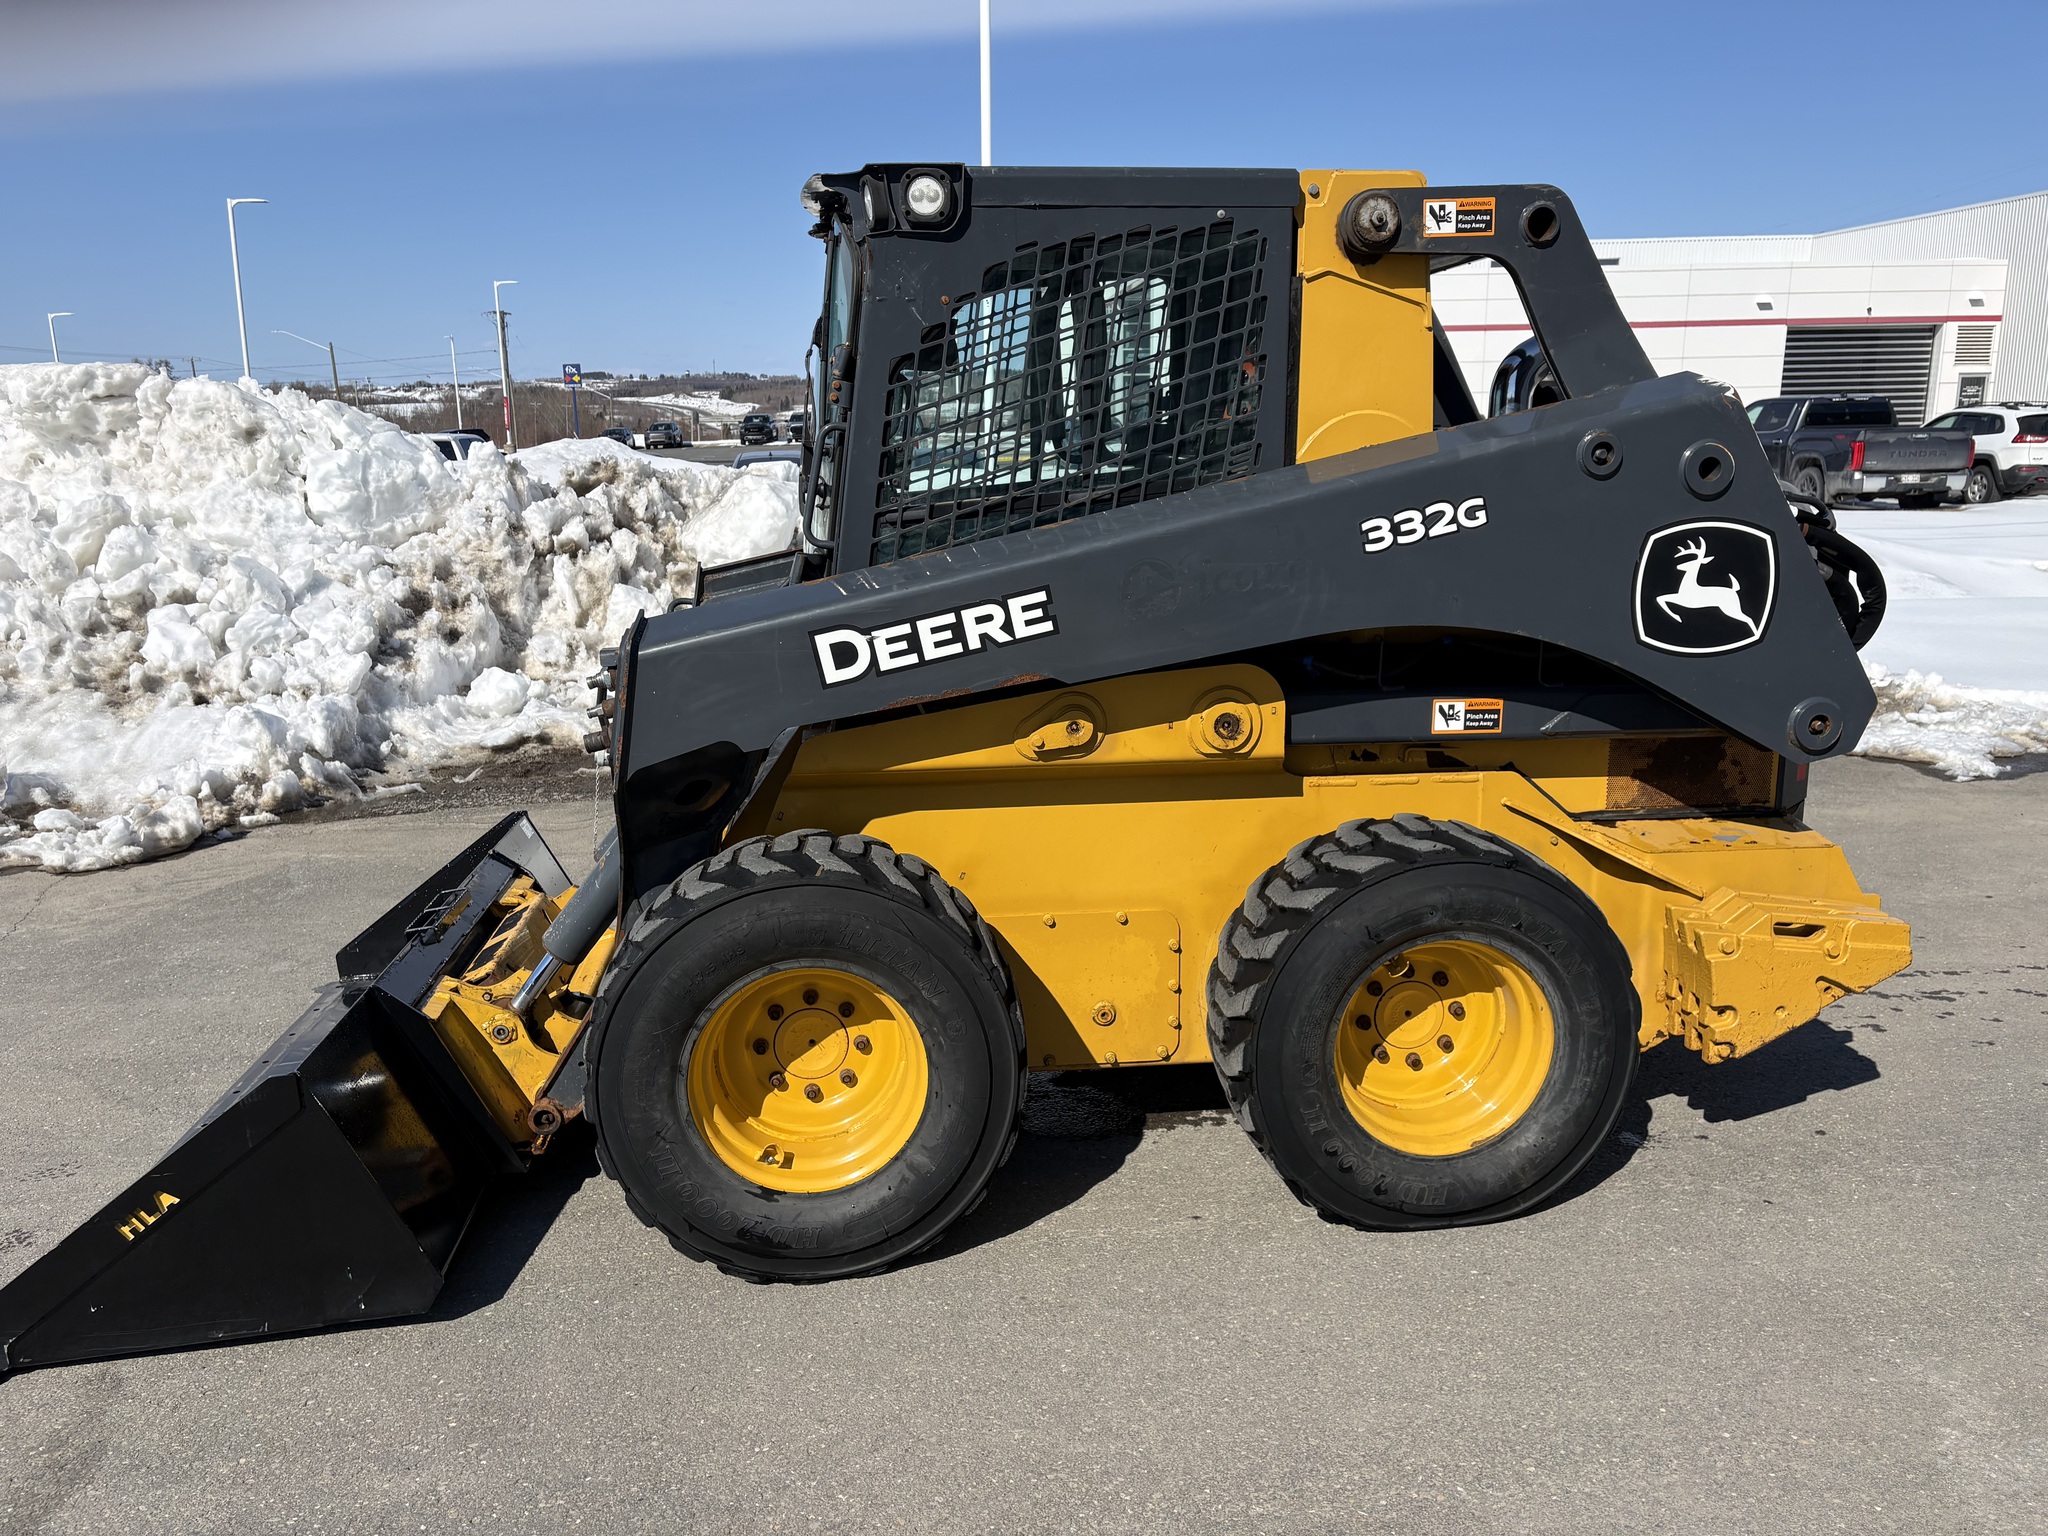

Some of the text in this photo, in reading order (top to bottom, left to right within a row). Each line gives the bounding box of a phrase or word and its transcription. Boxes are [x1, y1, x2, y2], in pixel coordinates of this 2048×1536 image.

[565, 365, 578, 374] fix
[1889, 450, 1948, 458] TUNDRA
[1360, 497, 1488, 553] 332G
[813, 589, 1055, 685] DEERE
[834, 924, 950, 999] TITAN
[1491, 903, 1593, 978] TITAN
[114, 1190, 181, 1242] HLA
